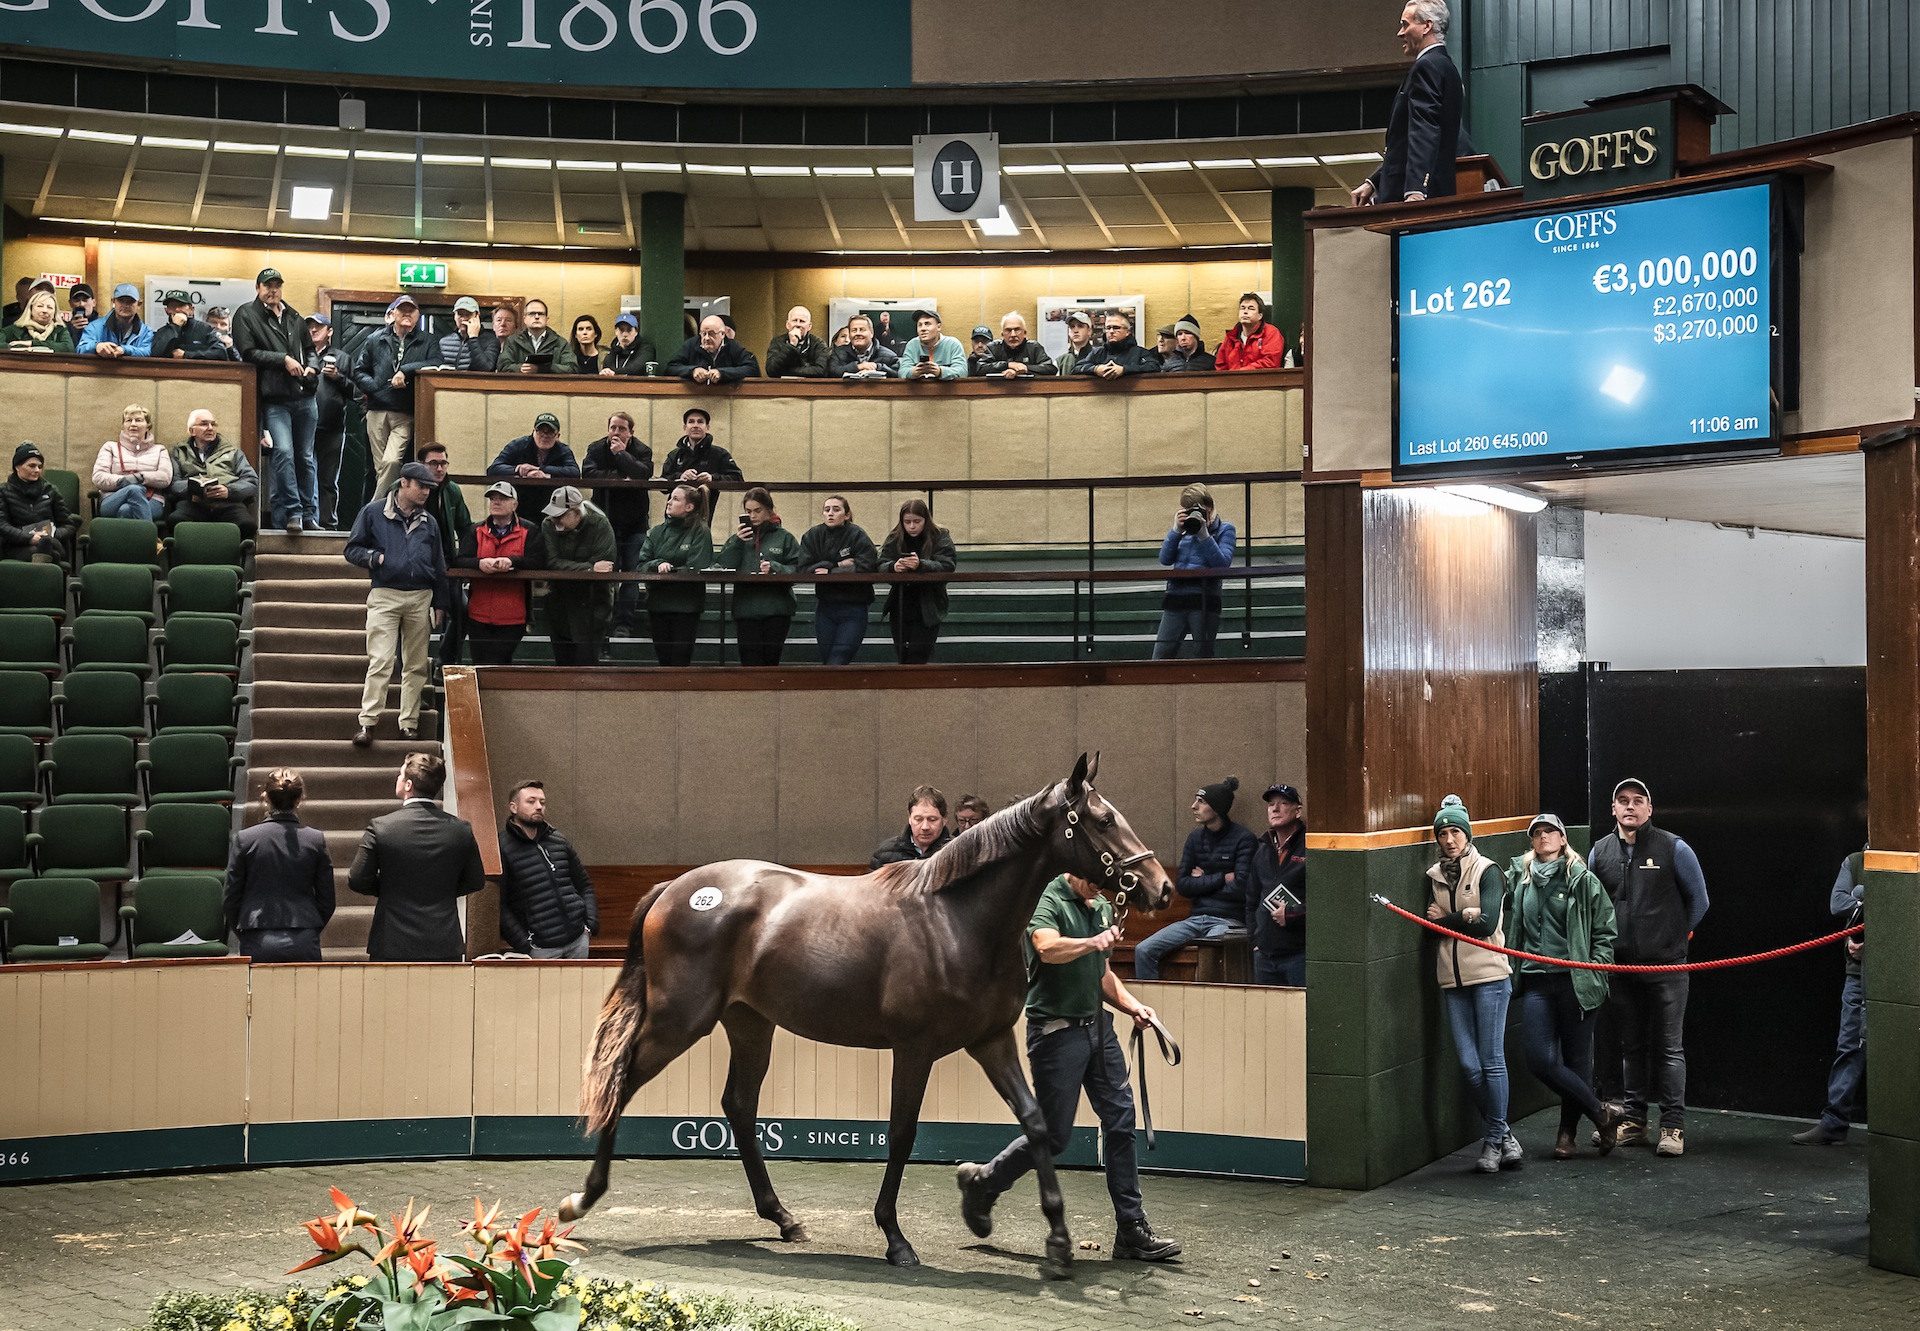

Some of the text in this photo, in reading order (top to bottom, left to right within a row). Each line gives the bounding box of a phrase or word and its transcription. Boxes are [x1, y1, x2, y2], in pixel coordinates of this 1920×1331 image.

[1529, 126, 1657, 180] GOFFS
[940, 160, 975, 195] H
[1534, 209, 1617, 244] GOFFS
[1552, 240, 1600, 254] SINCE 1866
[1592, 246, 1758, 295] €3,000,000
[1410, 285, 1455, 316] Lot
[1462, 277, 1511, 310] 262
[1653, 286, 1758, 317] £2,670,000
[1653, 313, 1758, 345] $3,270,000
[1689, 415, 1759, 434] 11:06 am
[1409, 431, 1549, 456] Last Lot 260 €45,000
[694, 895, 714, 906] 262
[672, 1120, 887, 1151] GOS SINCE 18
